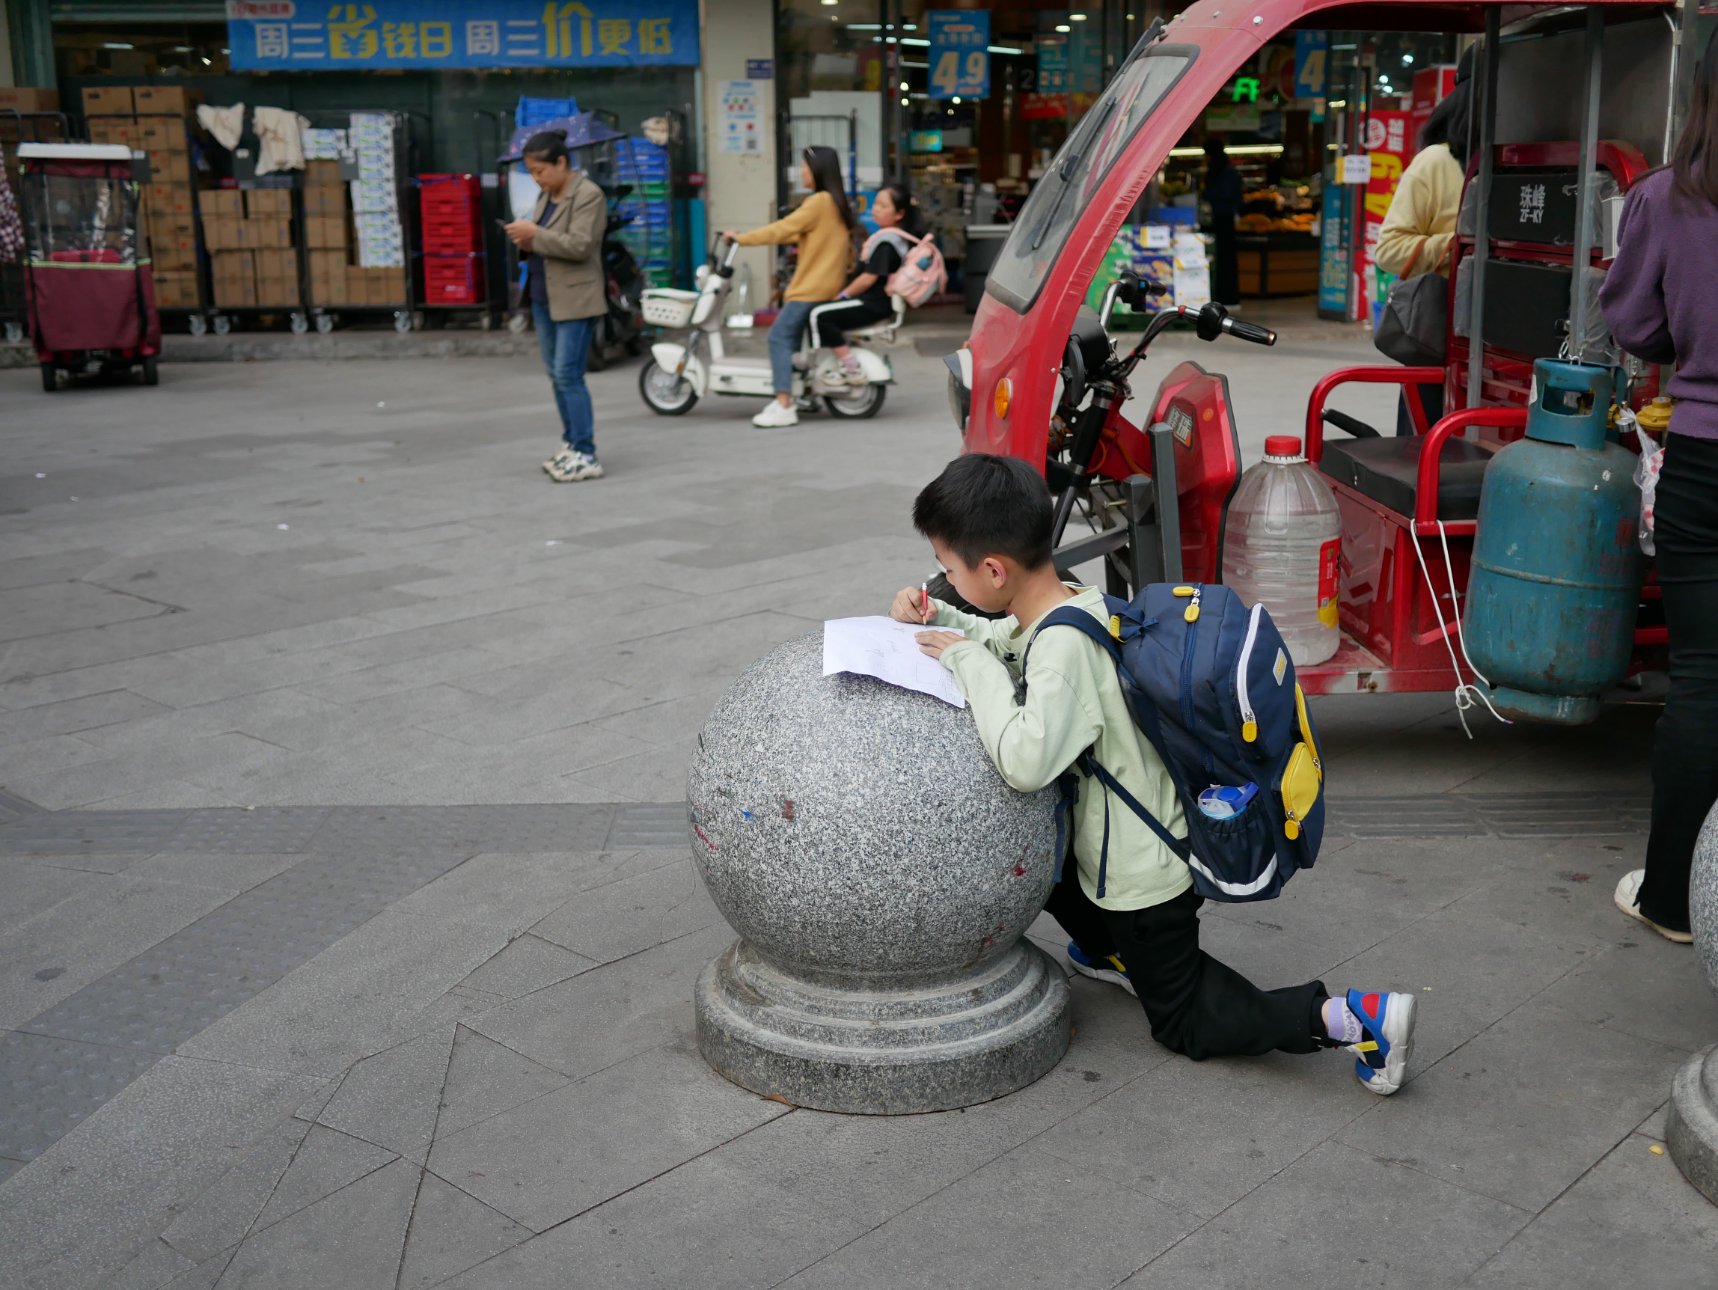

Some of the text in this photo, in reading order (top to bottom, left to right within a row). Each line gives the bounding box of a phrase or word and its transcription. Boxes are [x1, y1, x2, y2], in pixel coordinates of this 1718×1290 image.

[255, 2, 673, 59] 周三省钱日 周三价更低
[1520, 184, 1546, 209] 珠峰
